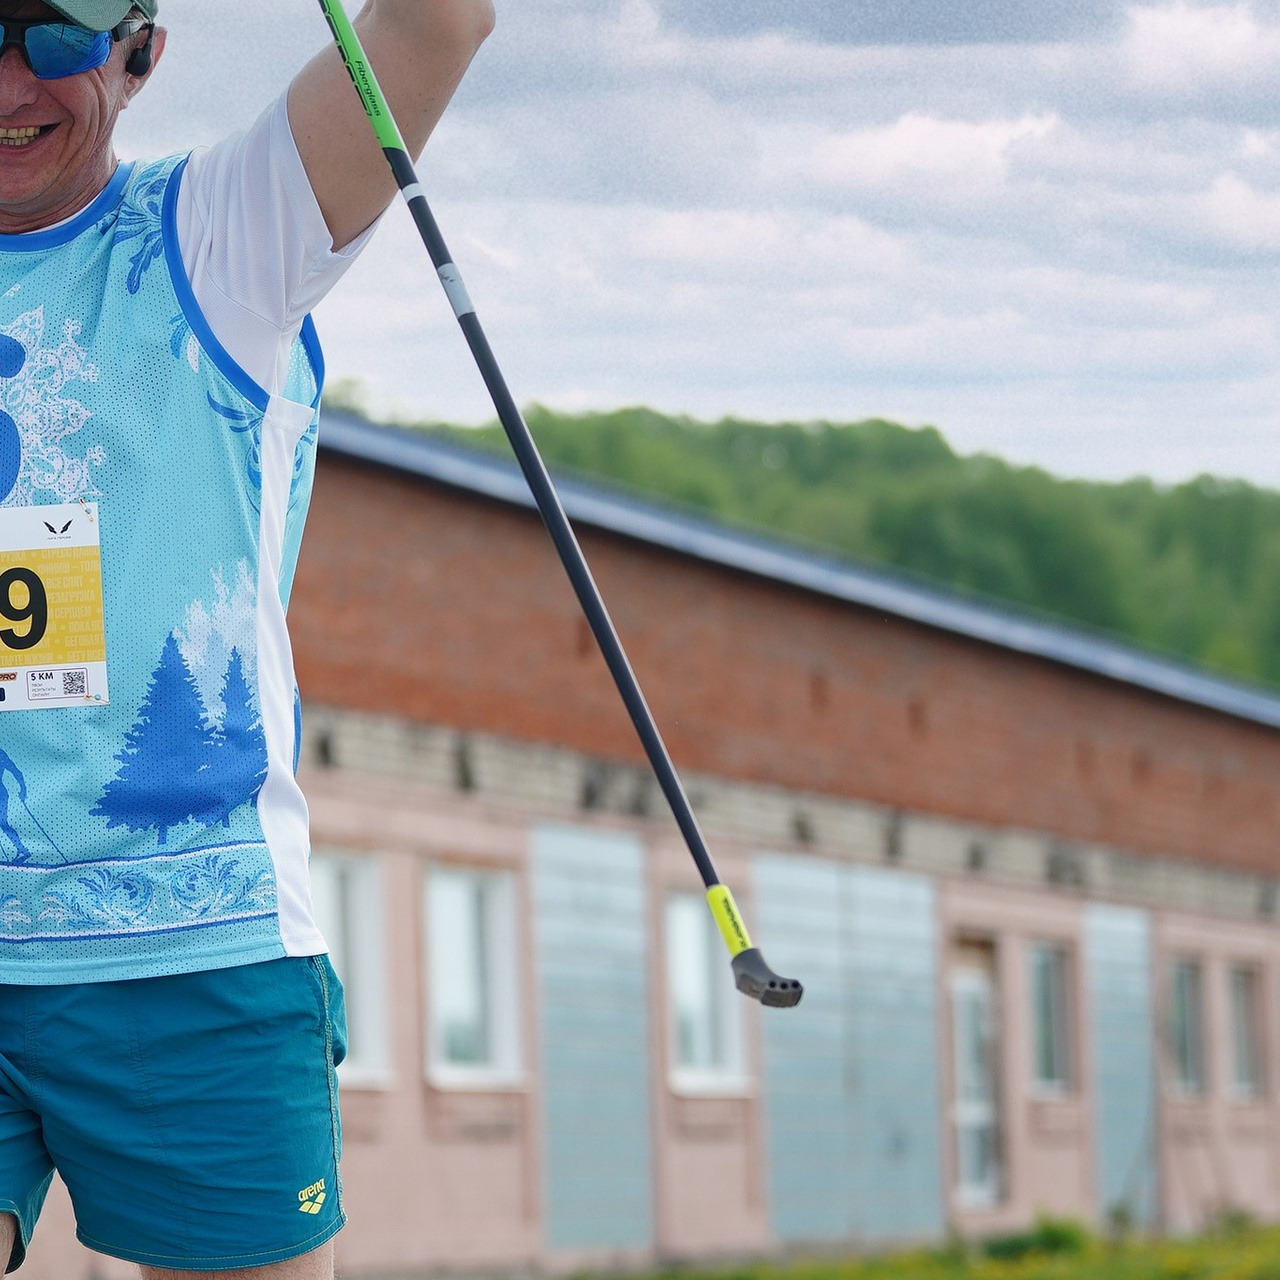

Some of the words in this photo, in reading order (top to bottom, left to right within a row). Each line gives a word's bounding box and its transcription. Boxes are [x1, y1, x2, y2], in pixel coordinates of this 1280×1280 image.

[354, 60, 382, 117] Fiberglass
[30, 672, 36, 681] 5
[298, 1178, 325, 1202] arena
